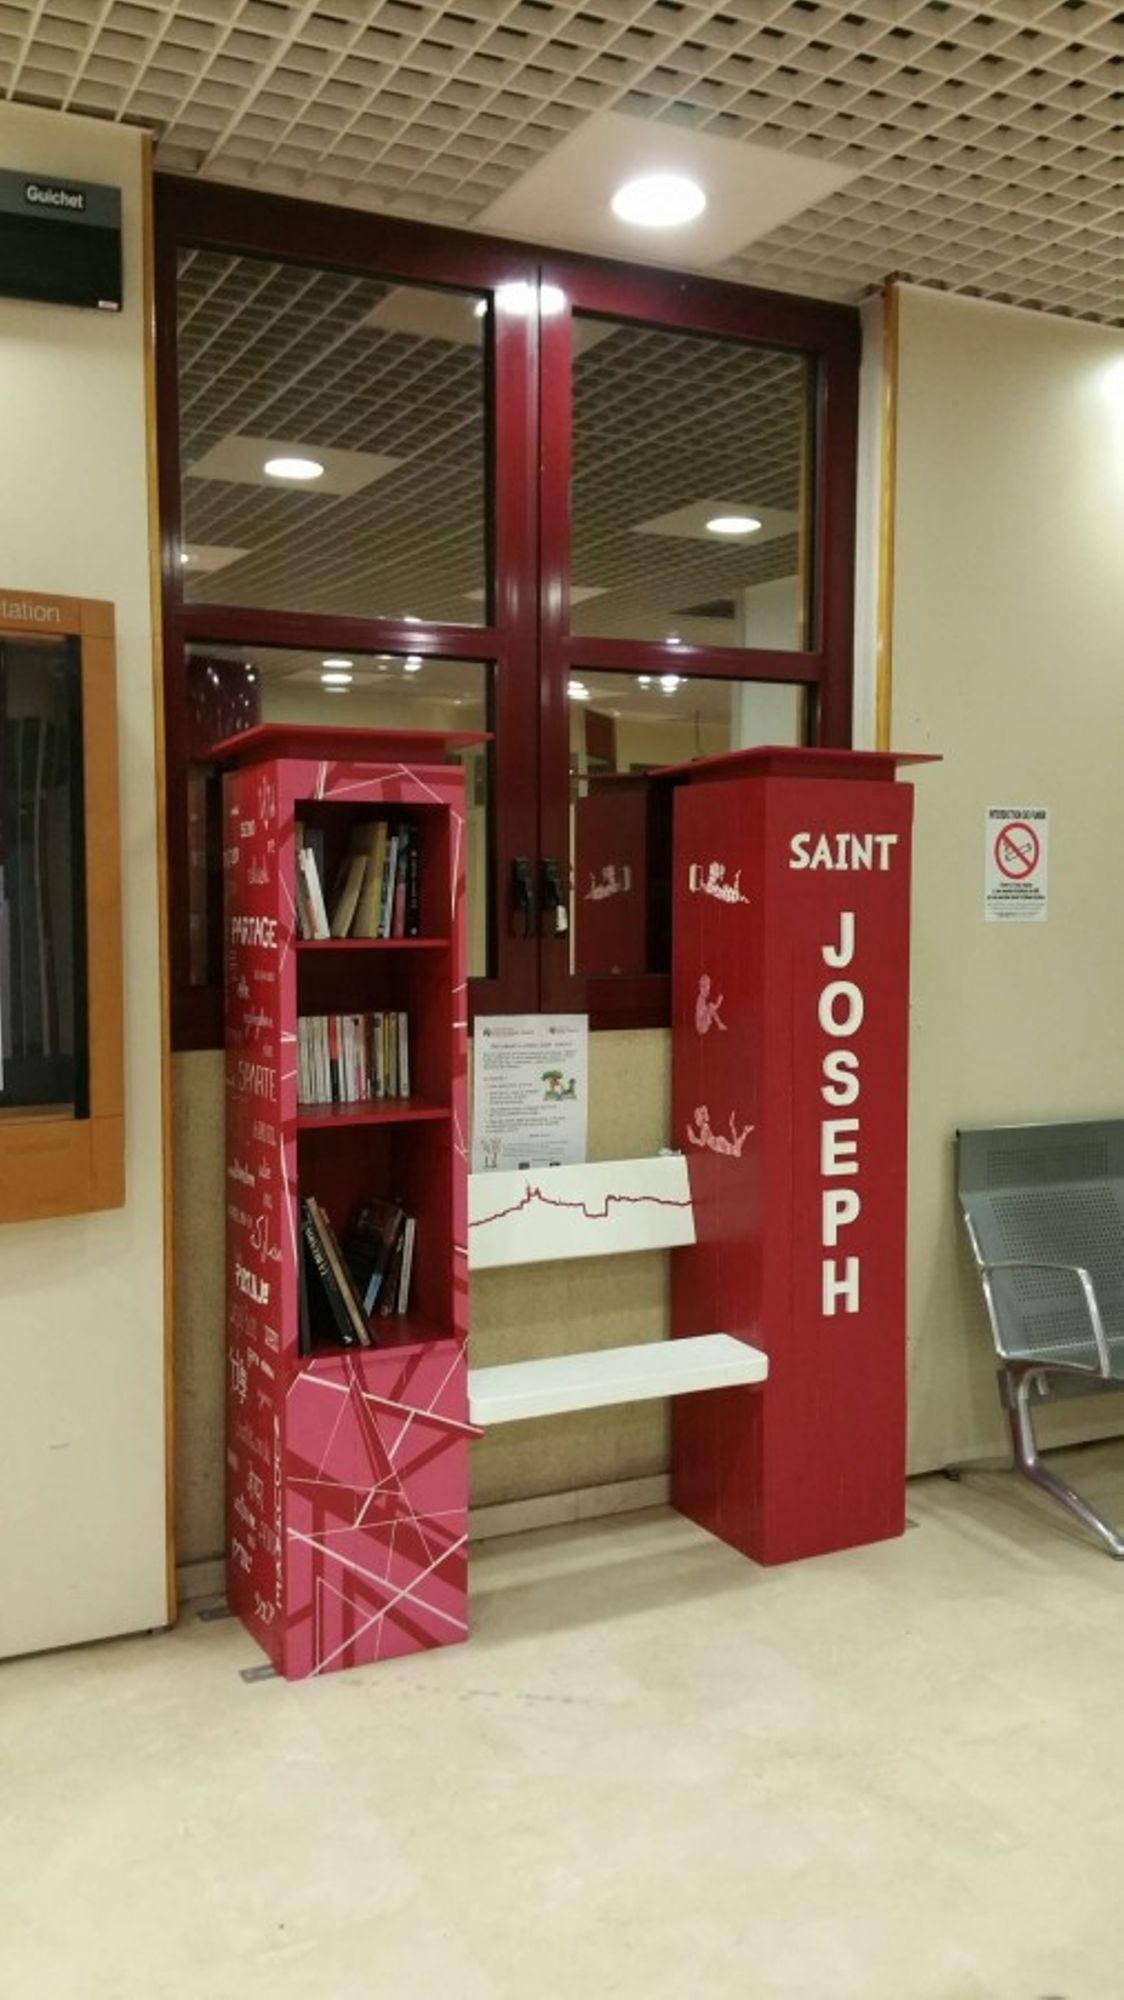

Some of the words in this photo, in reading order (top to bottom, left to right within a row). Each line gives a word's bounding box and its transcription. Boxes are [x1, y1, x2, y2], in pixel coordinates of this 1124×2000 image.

[26, 184, 84, 209] Guichet
[789, 832, 898, 872] SAINT
[231, 915, 278, 949] PARTAGE
[817, 911, 865, 1317] JOSEPH
